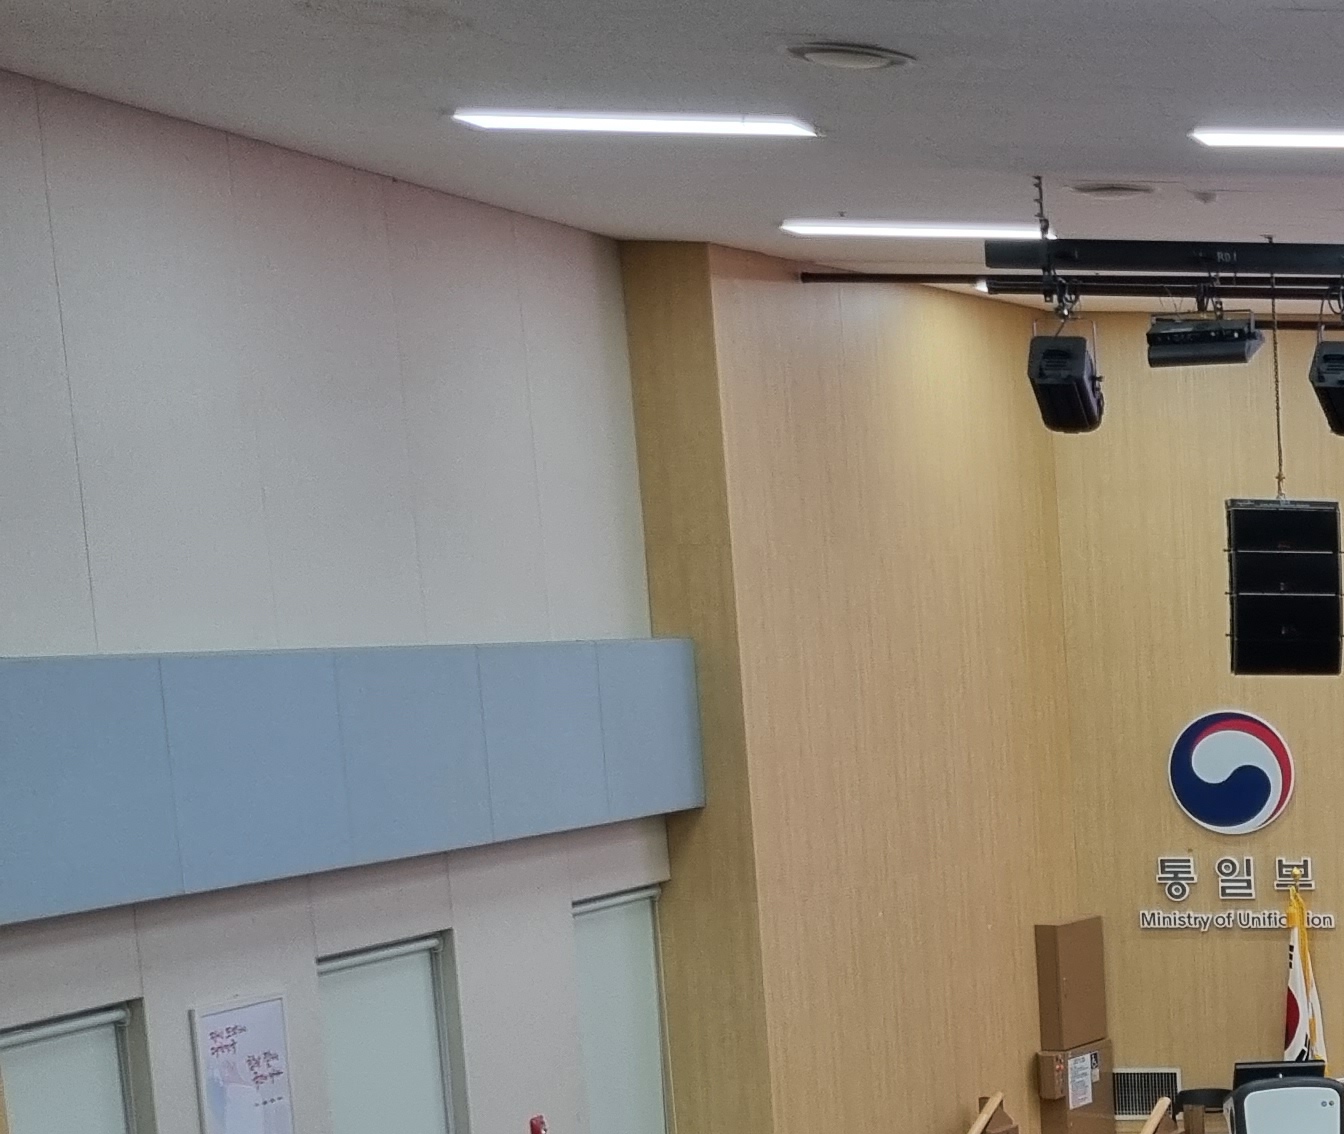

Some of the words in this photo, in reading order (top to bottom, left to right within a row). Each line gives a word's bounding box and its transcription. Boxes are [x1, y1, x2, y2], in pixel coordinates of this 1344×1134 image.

[1140, 910, 1210, 932] Ministry
[1214, 911, 1233, 928] of
[1237, 910, 1335, 929] Unificion
